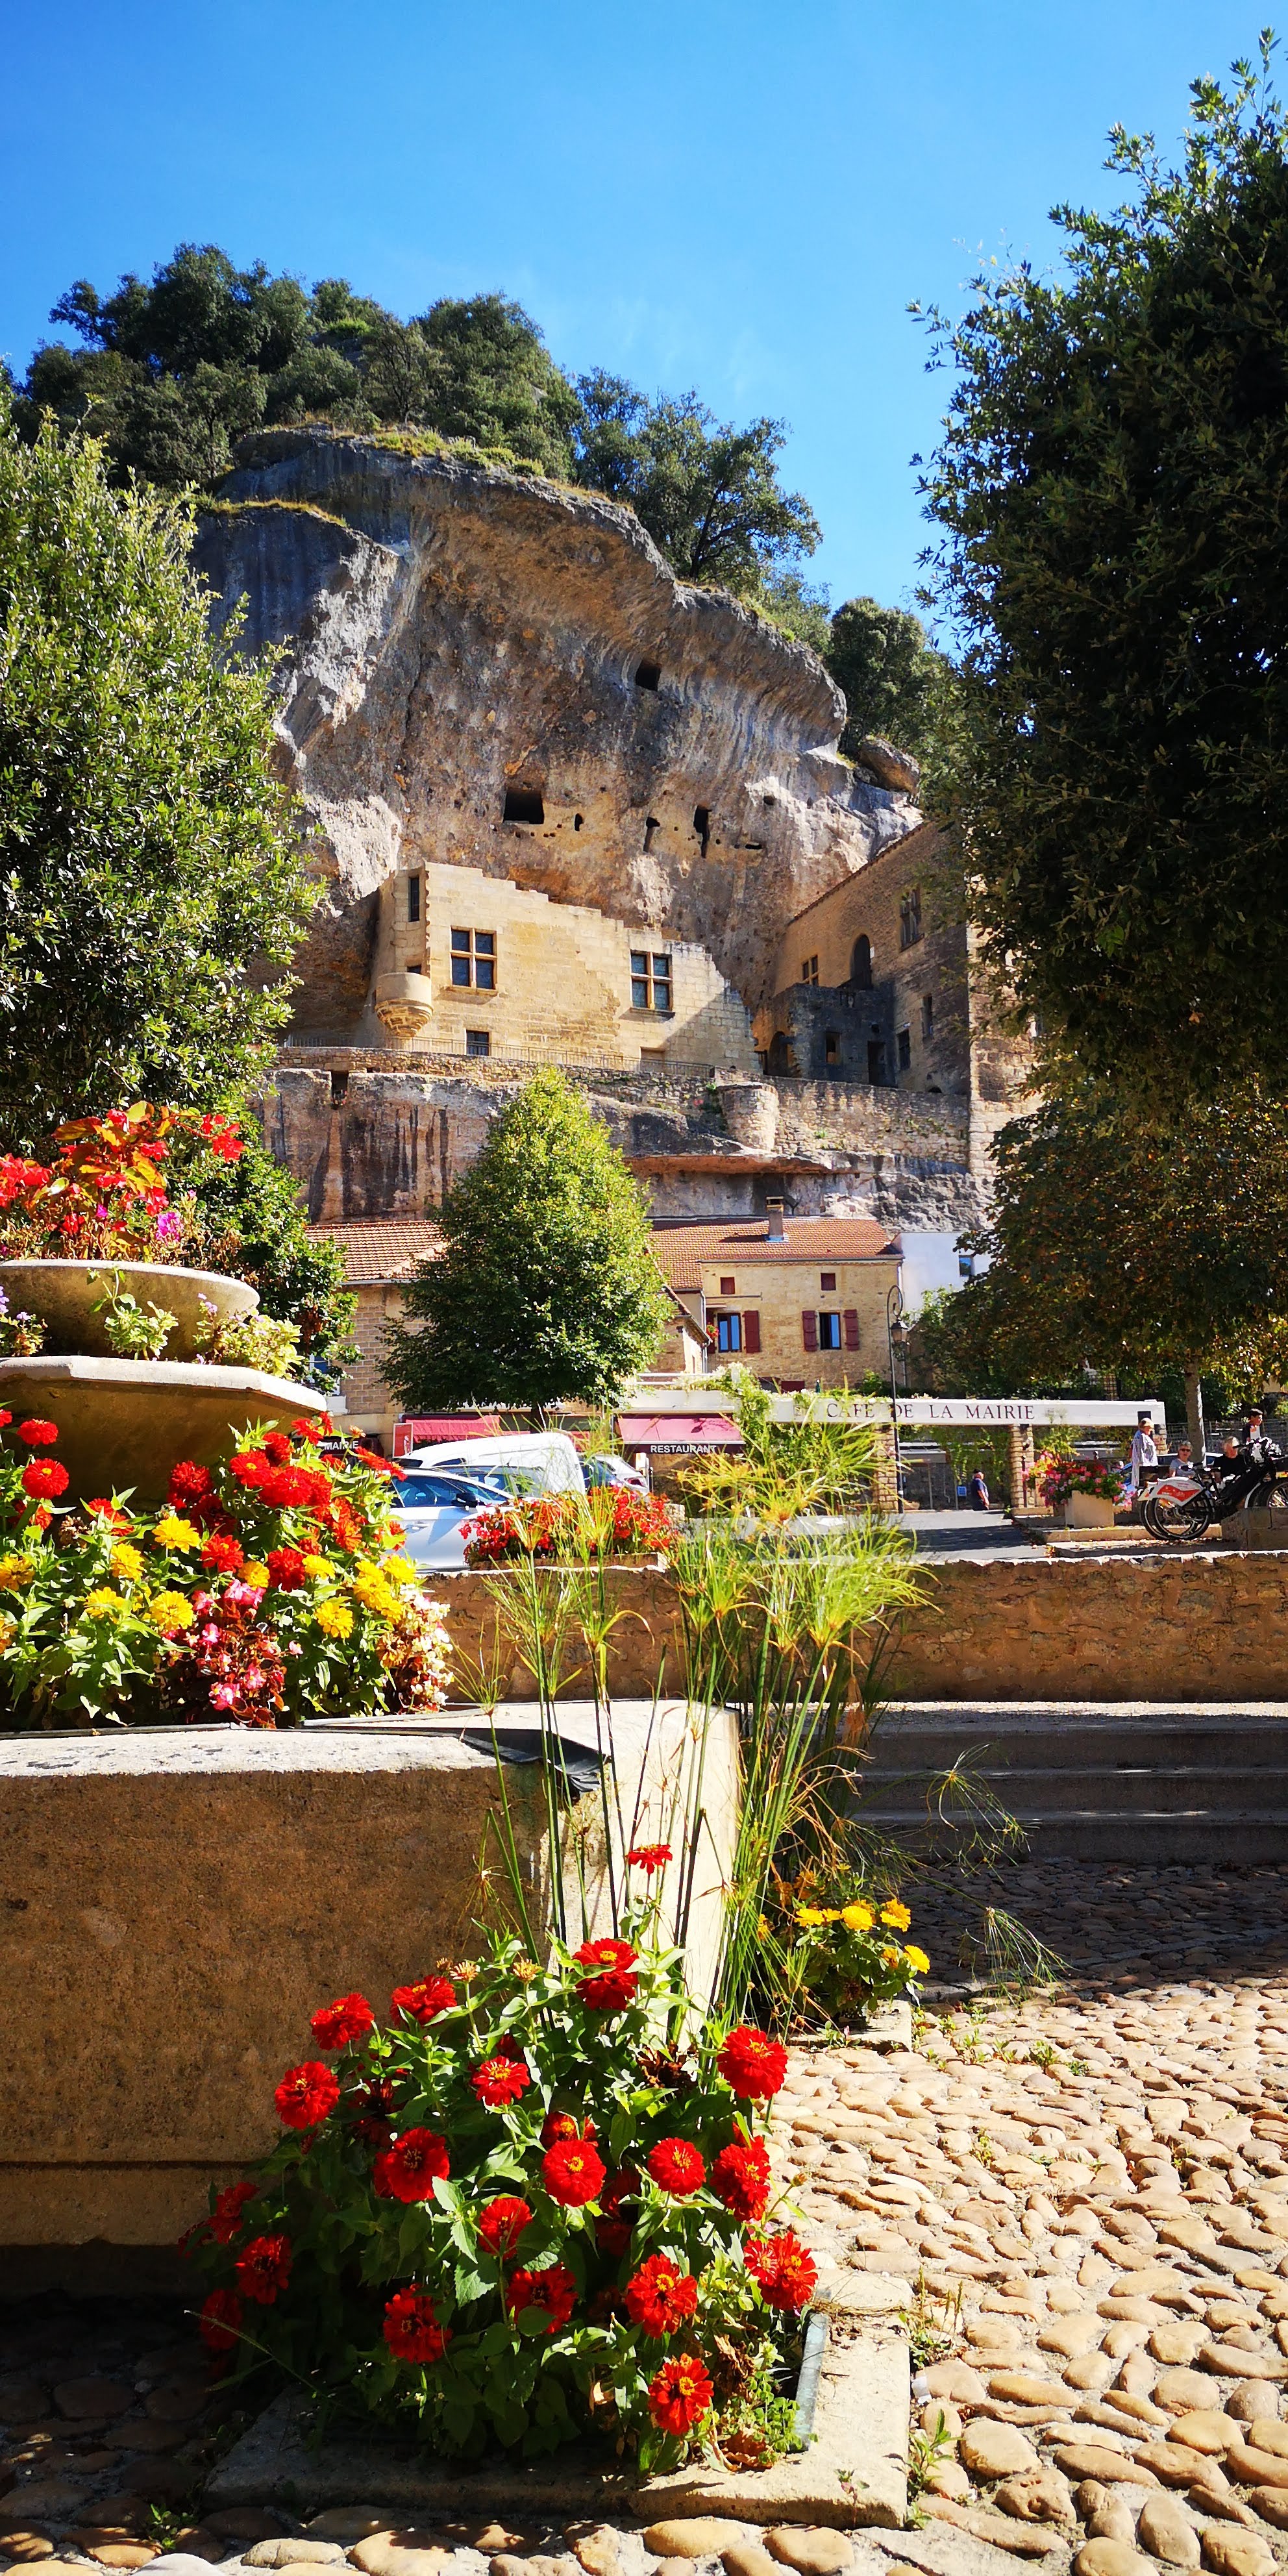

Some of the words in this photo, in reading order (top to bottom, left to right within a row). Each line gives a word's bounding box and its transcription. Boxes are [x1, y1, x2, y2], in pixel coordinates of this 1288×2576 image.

[887, 1403, 914, 1418] DE
[928, 1404, 953, 1419] LA
[965, 1404, 1035, 1420] MAIRIE
[650, 1444, 717, 1454] RESTAURANT
